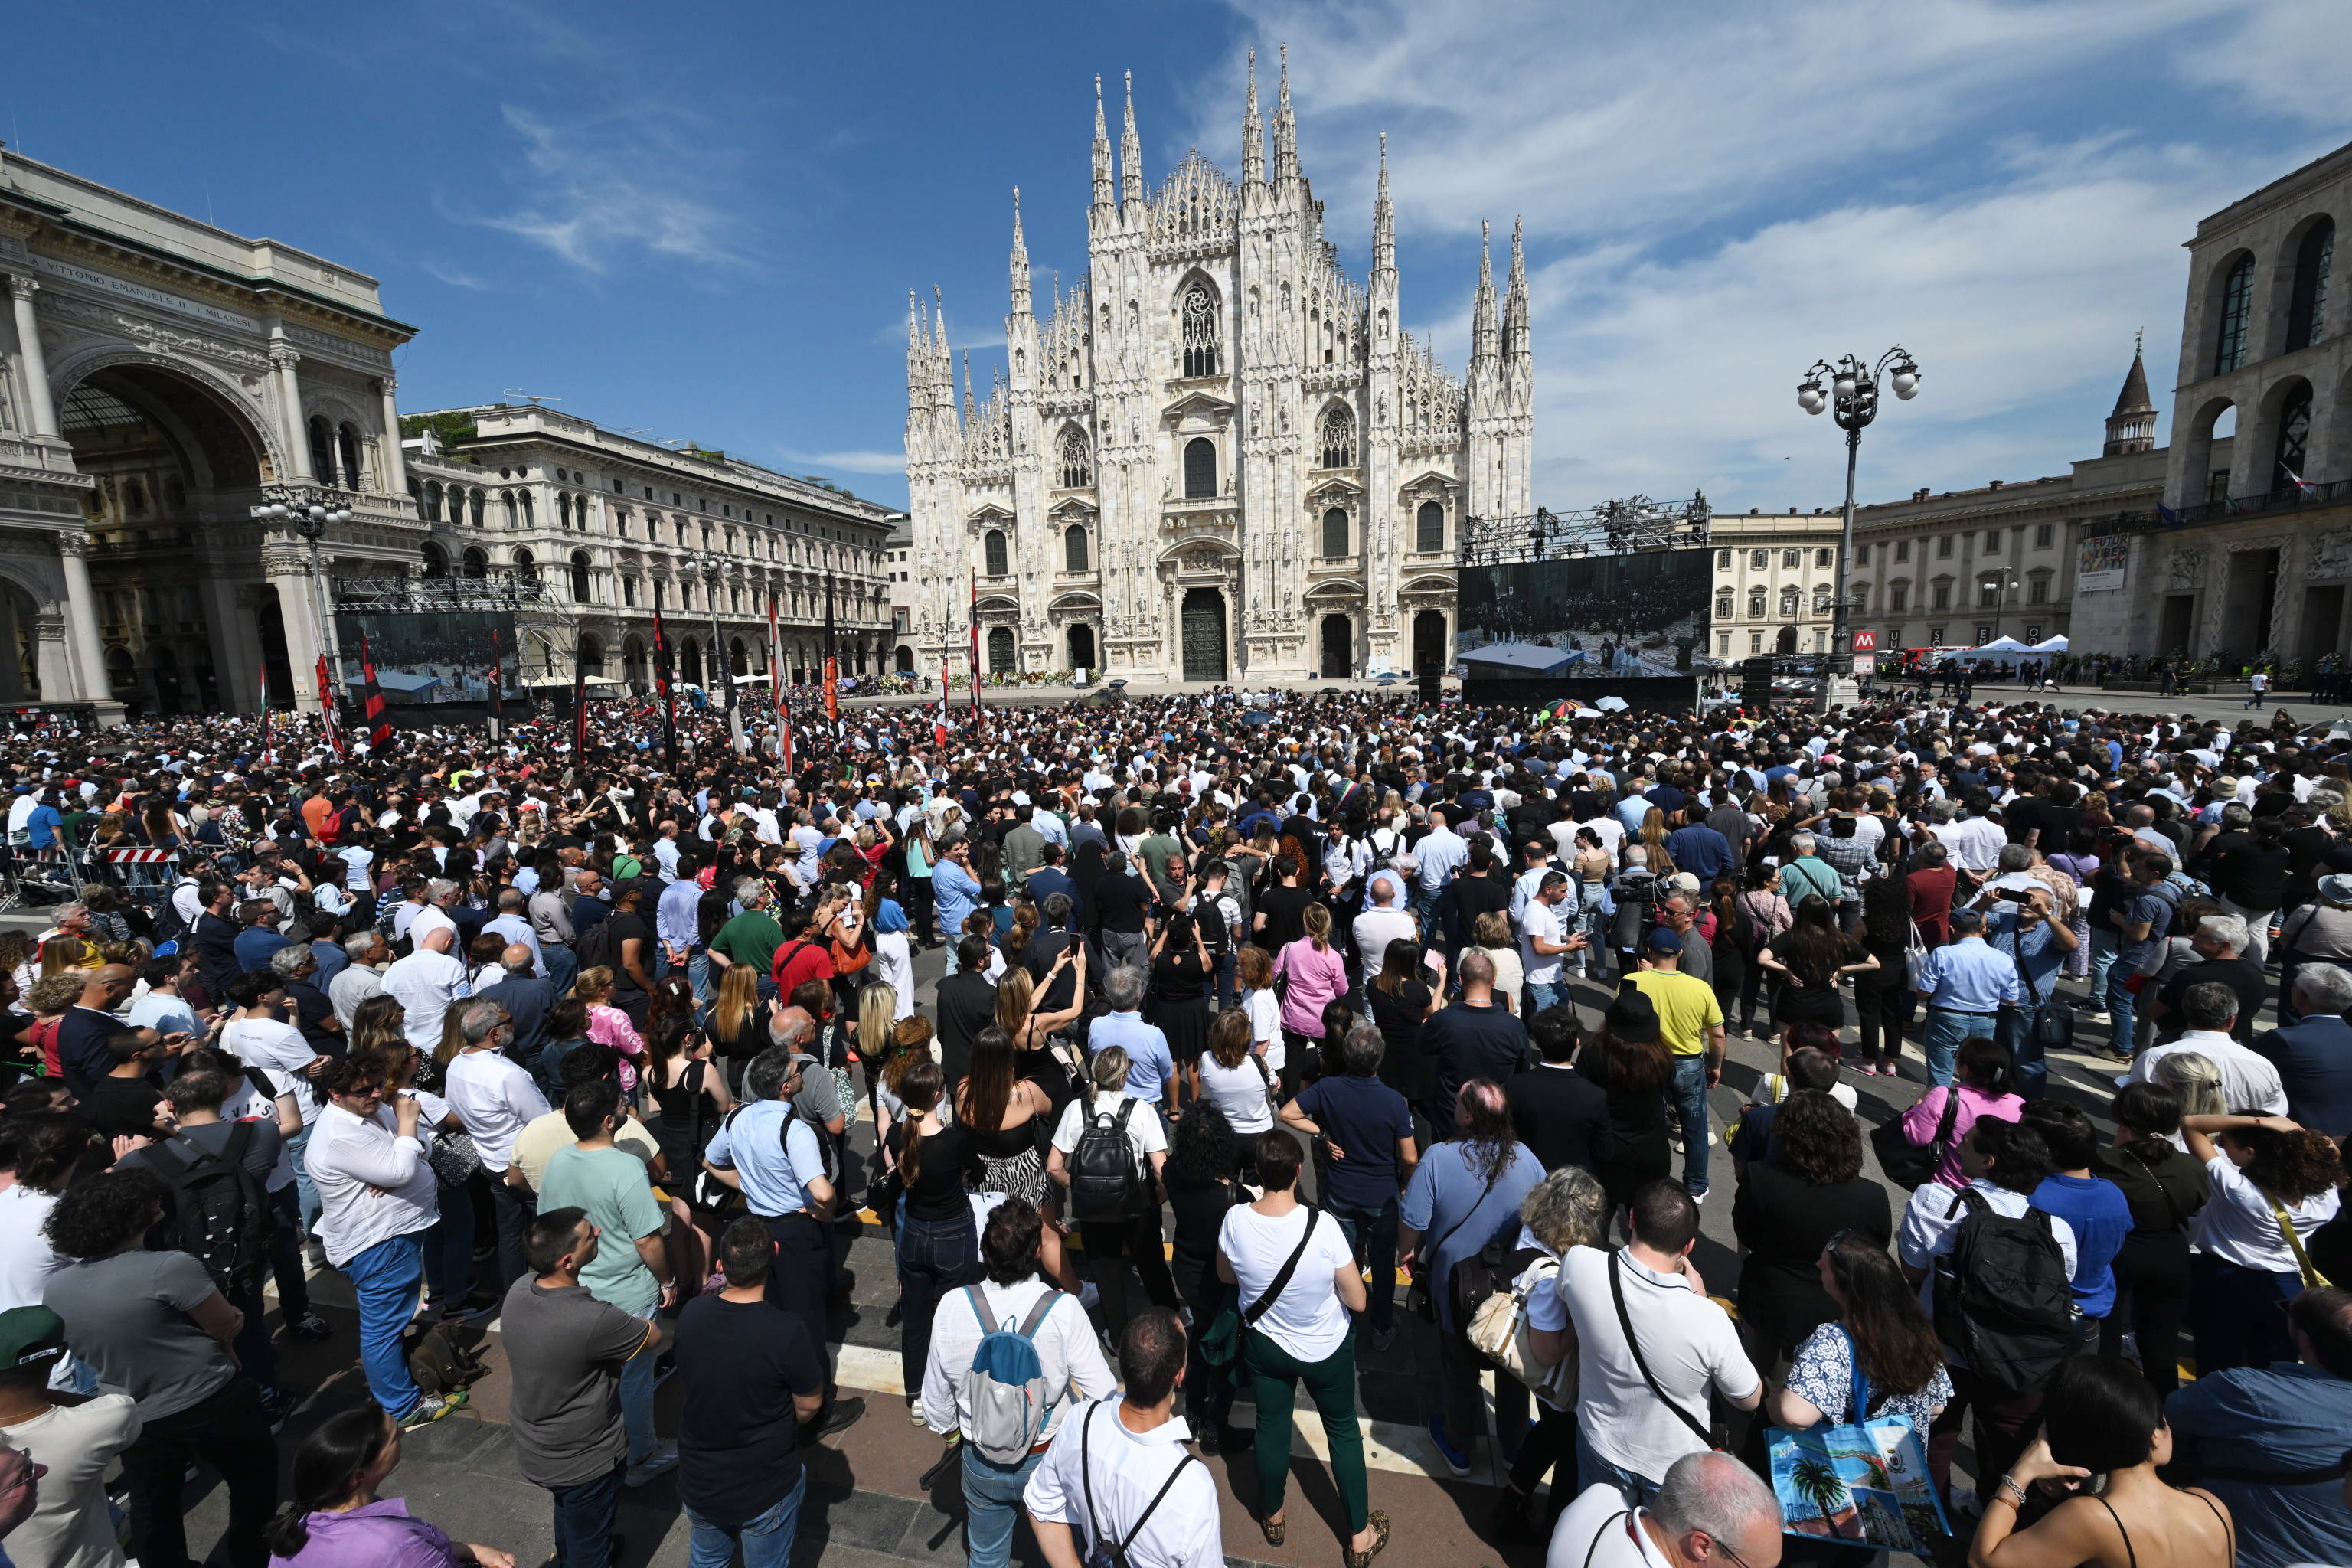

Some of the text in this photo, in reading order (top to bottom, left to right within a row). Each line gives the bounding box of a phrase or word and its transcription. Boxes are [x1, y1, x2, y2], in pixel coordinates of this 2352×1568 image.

[47, 262, 105, 285] VITTORIO
[111, 281, 174, 305] EMANUELE
[206, 309, 251, 328] MILANESI
[1855, 635, 1873, 646] M
